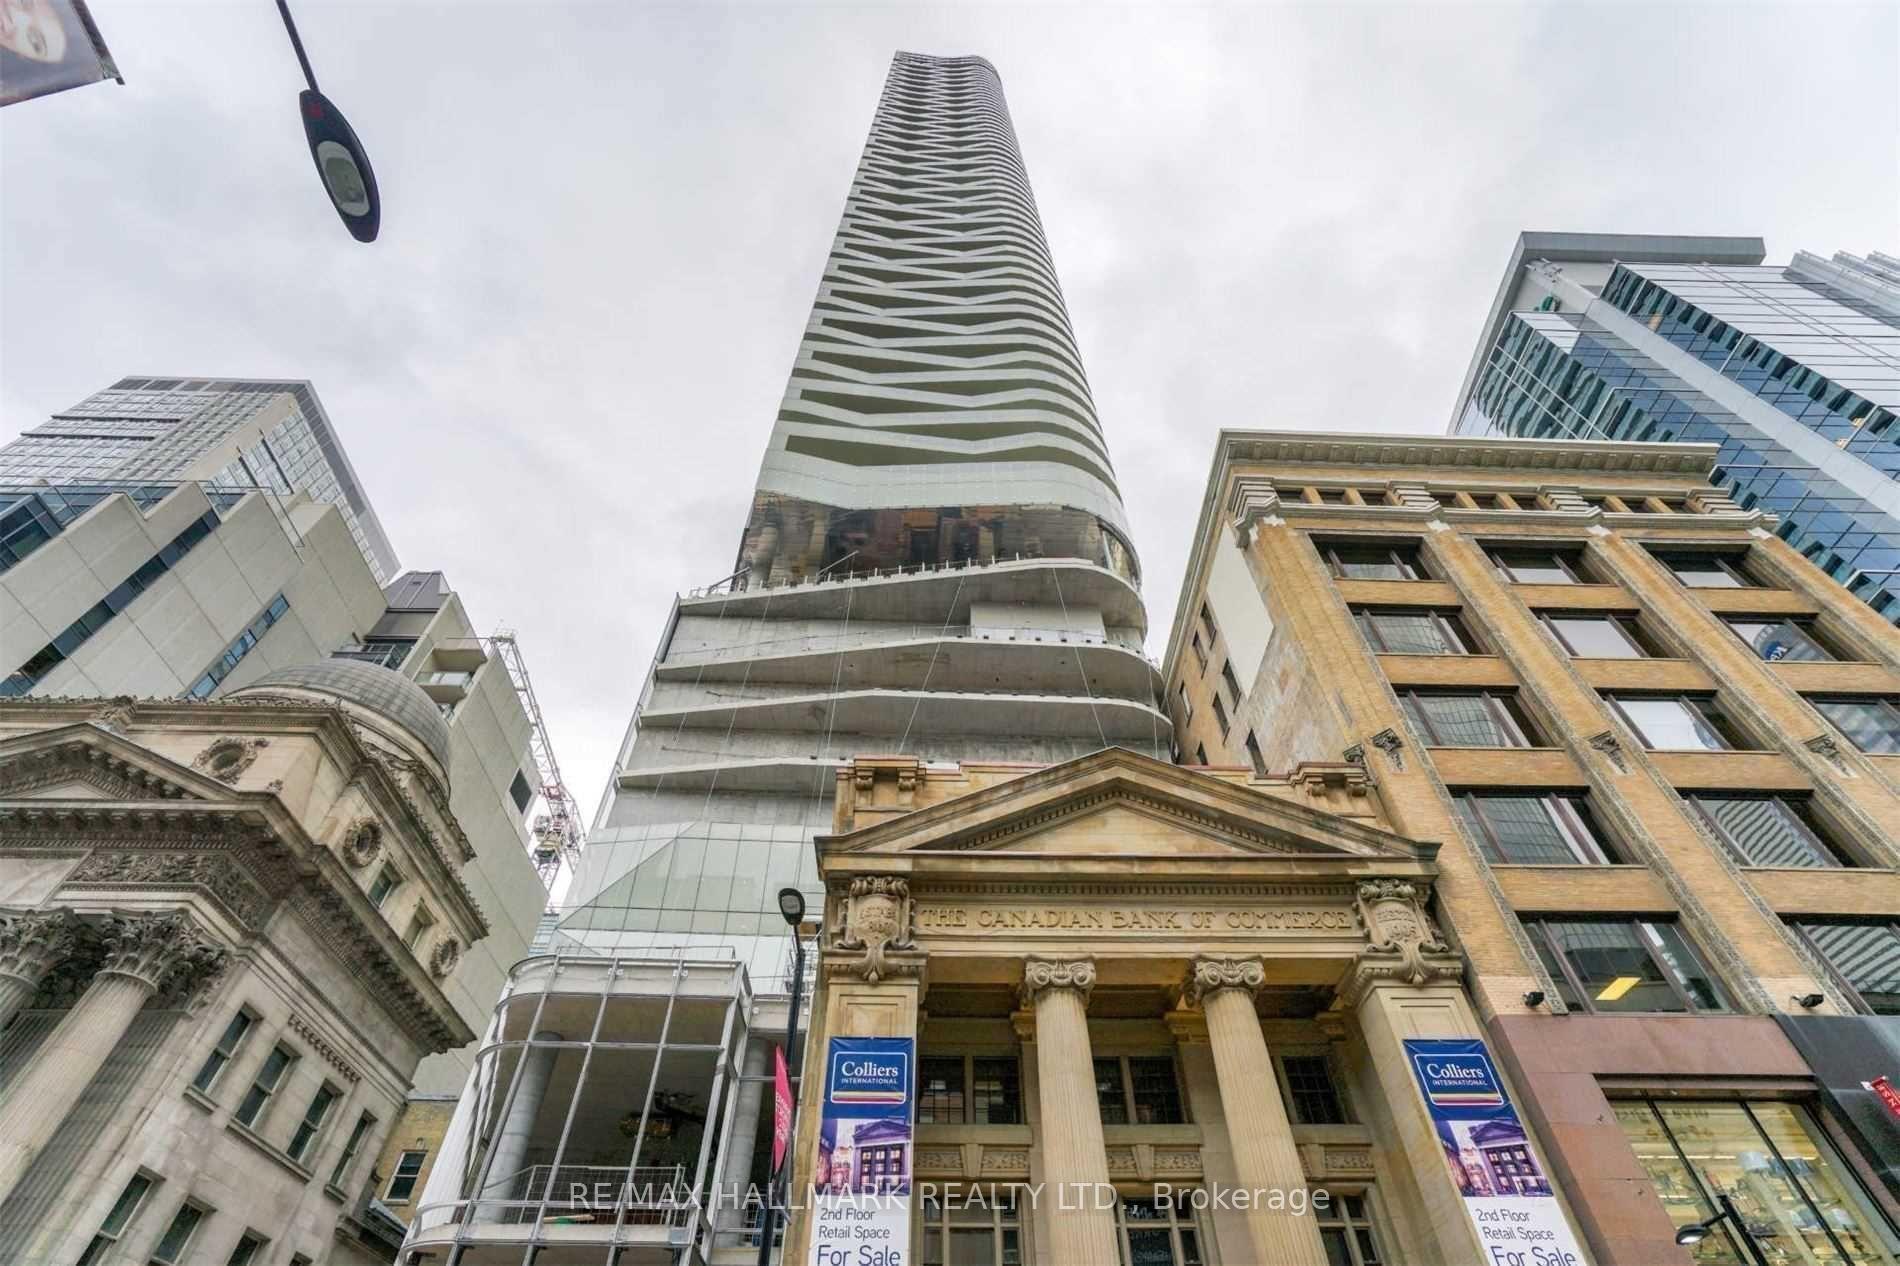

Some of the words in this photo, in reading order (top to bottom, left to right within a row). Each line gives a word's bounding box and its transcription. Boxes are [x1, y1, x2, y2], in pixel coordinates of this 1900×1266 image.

[920, 908, 967, 928] THE
[976, 910, 1104, 929] CANADIAN
[1111, 911, 1182, 929] BANK
[1190, 911, 1217, 929] OF
[1224, 911, 1352, 930] COMMERCE
[841, 1060, 899, 1078] Colliers
[1426, 1063, 1485, 1079] Colliers
[820, 1208, 842, 1221] 2nd
[845, 1208, 876, 1221] Floor
[1476, 1208, 1499, 1222] 2nd
[1501, 1208, 1530, 1222] Floor
[818, 1225, 850, 1239] Retail
[854, 1225, 891, 1241] Space
[1483, 1226, 1515, 1240] Retail
[1518, 1226, 1555, 1242] Space
[817, 1244, 852, 1266] For
[858, 1243, 901, 1266] Sale
[1490, 1245, 1525, 1266] For
[1532, 1244, 1577, 1266] Sale
